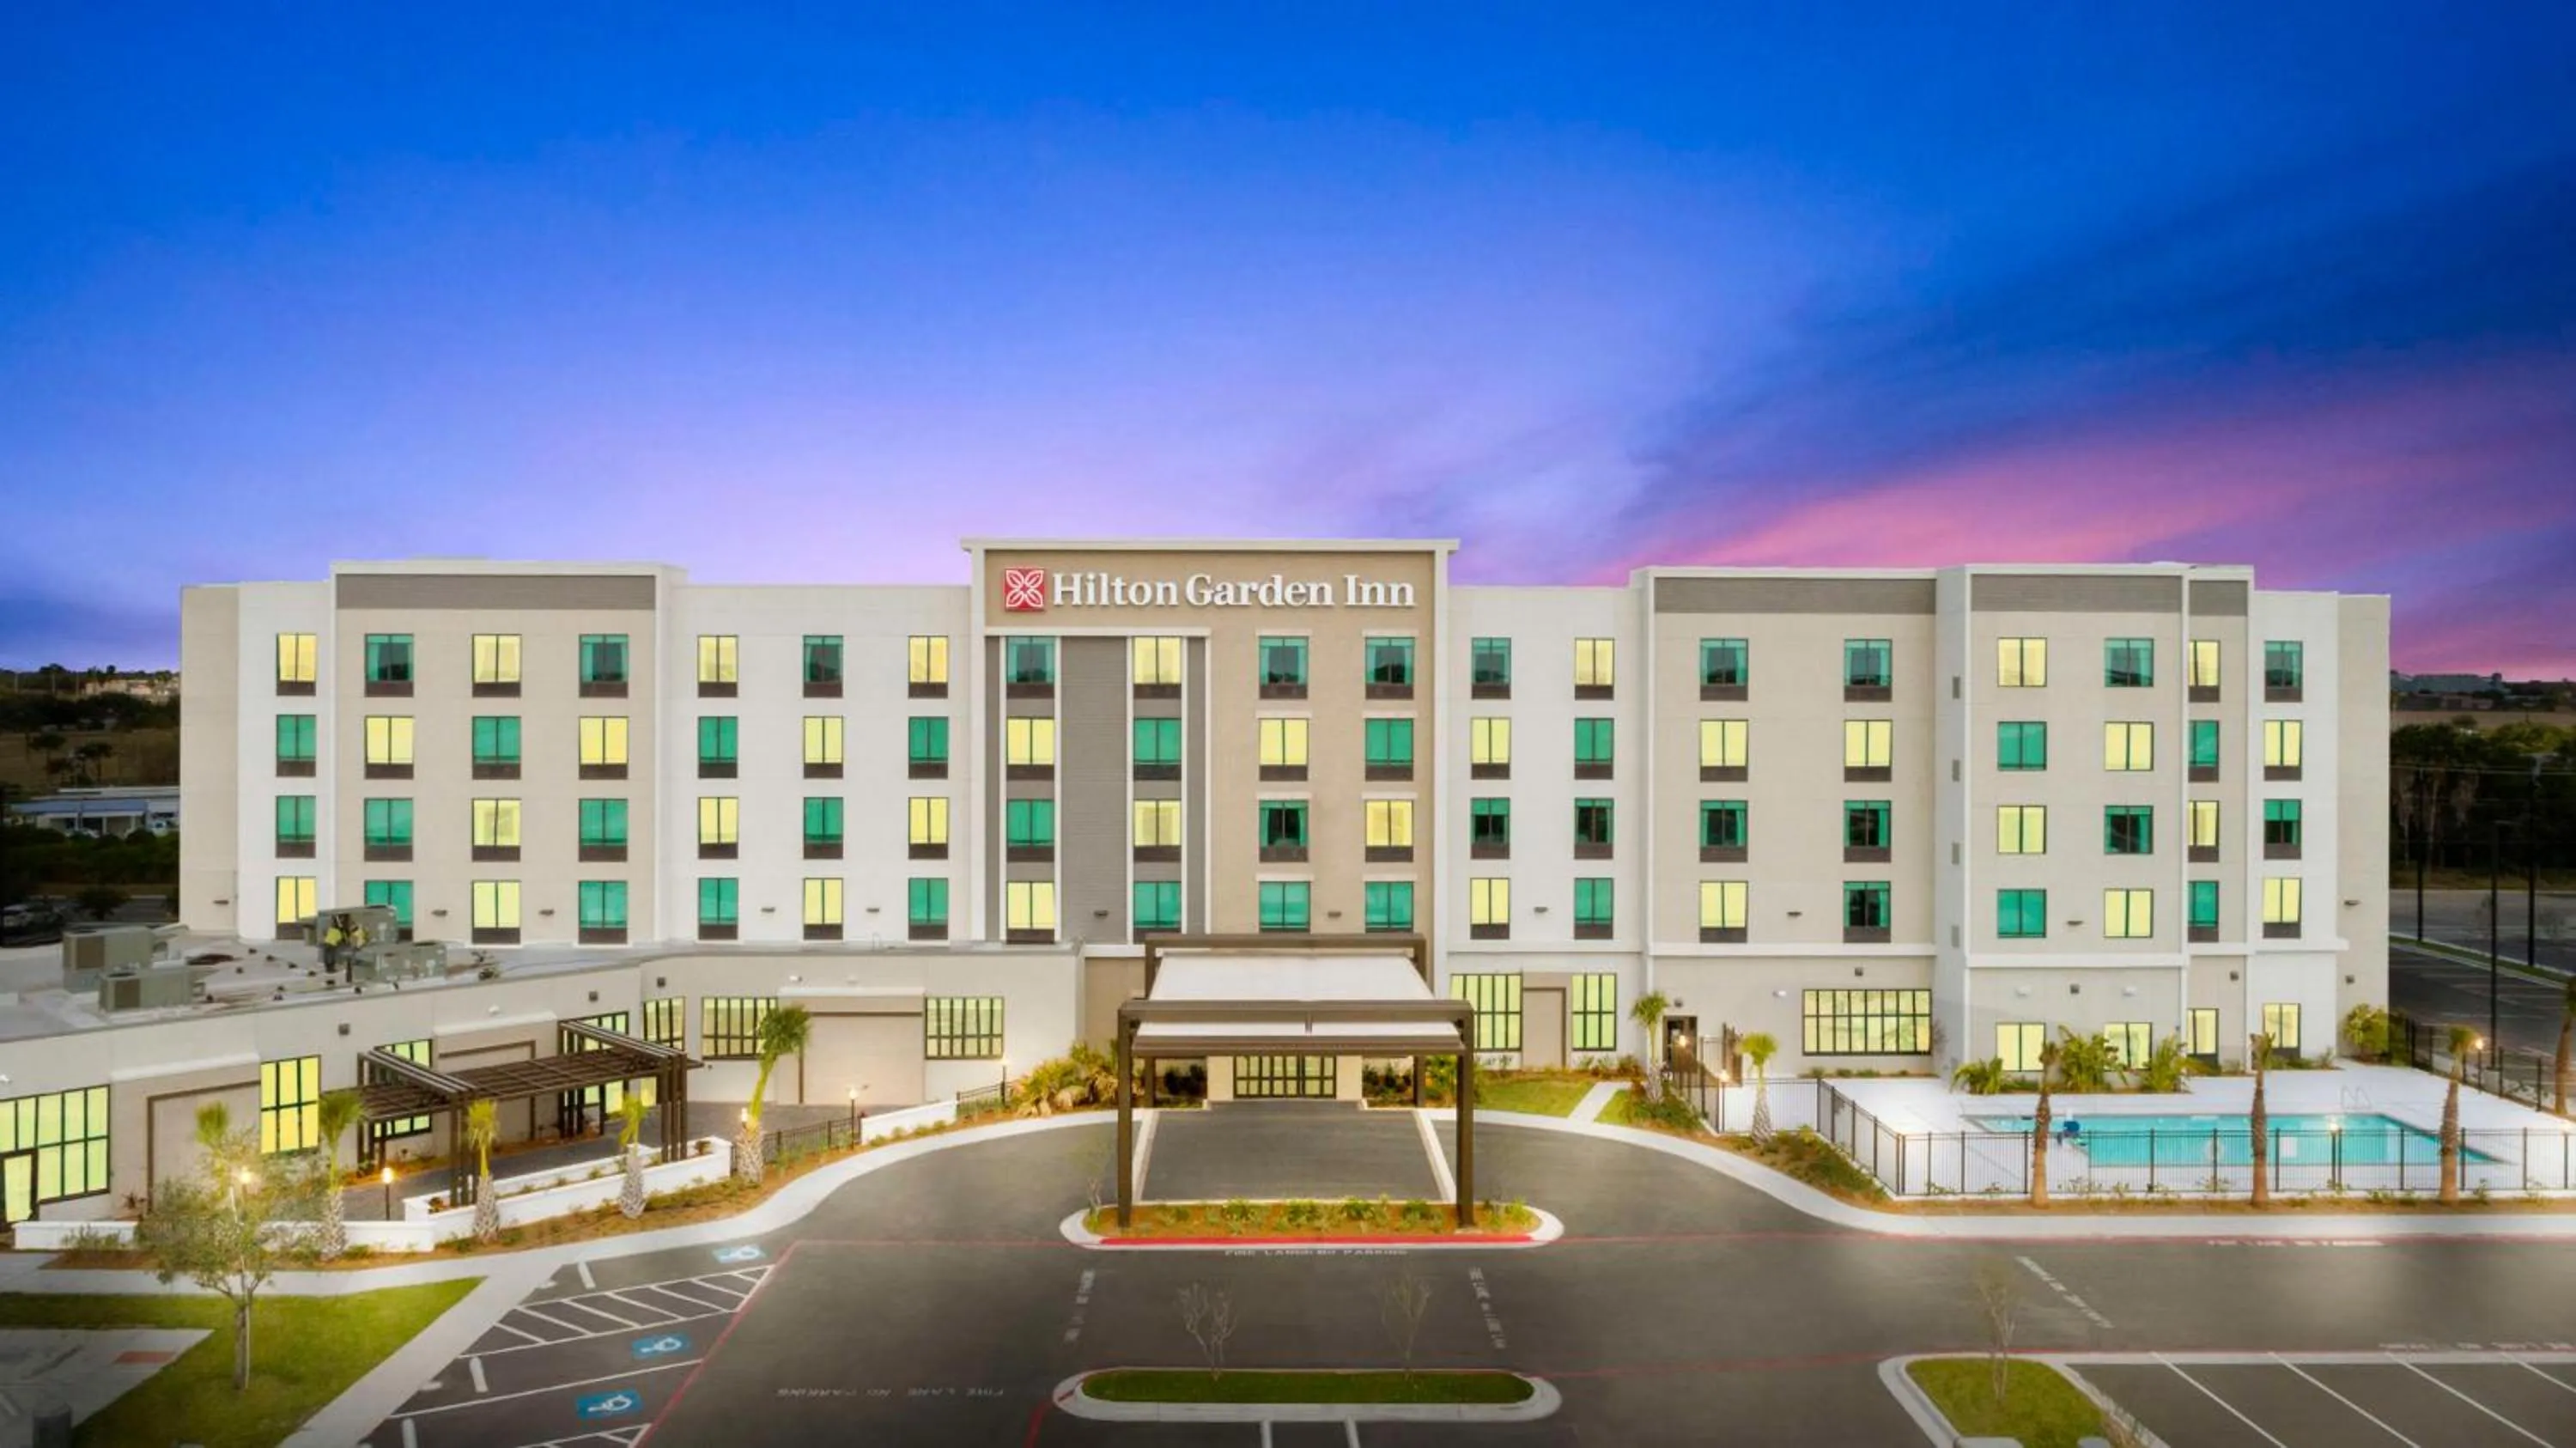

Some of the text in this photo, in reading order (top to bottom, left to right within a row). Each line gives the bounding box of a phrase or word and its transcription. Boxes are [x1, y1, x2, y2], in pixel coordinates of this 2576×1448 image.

[1052, 571, 1416, 607] Hilton Garden Inn
